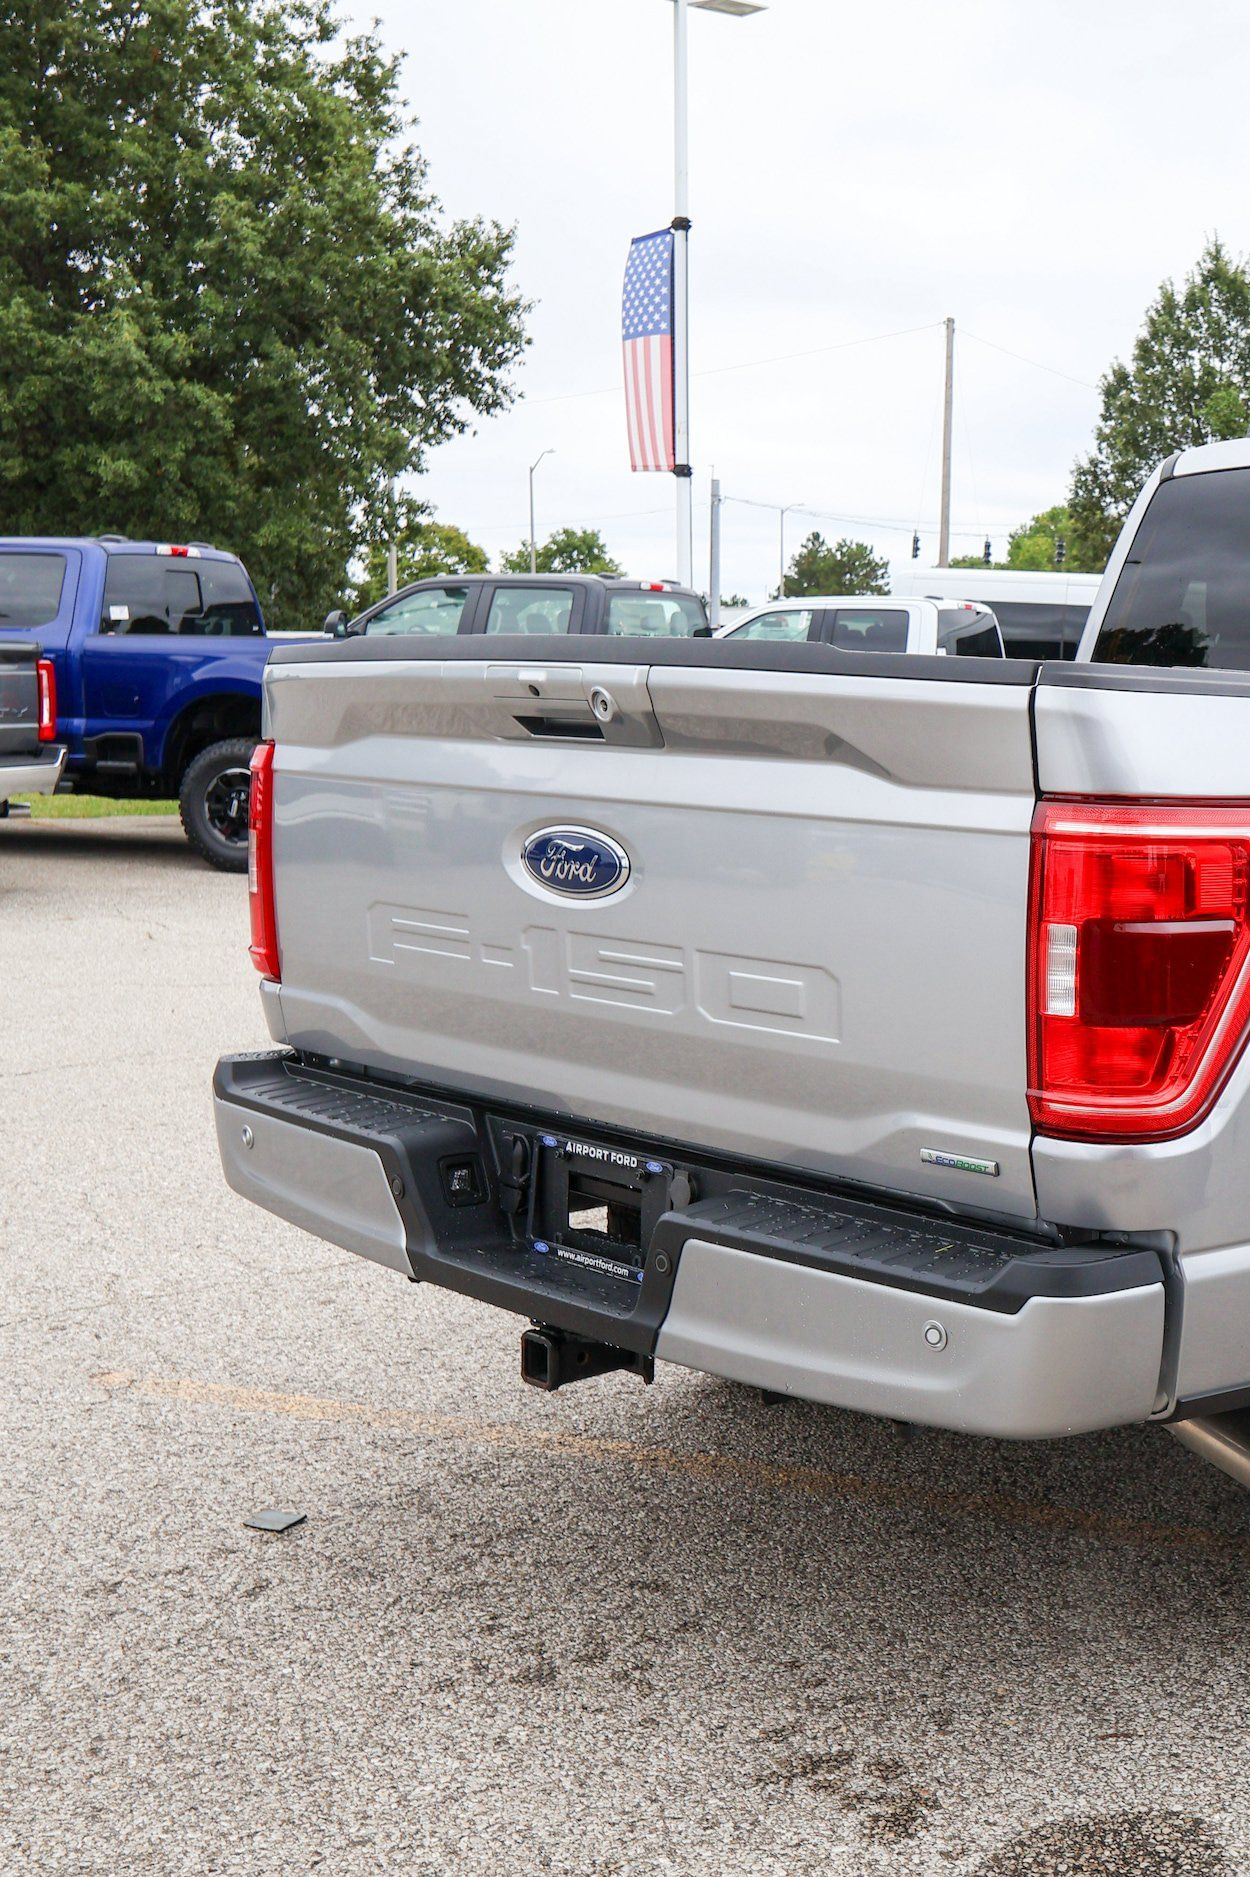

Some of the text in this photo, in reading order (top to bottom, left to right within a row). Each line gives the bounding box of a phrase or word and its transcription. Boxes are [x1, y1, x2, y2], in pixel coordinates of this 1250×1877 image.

[540, 839, 599, 883] Ford
[366, 900, 843, 1044] F-150
[565, 1141, 609, 1161] AIRPORT
[610, 1152, 638, 1168] FORD
[556, 1248, 630, 1278] www.airportford.com
